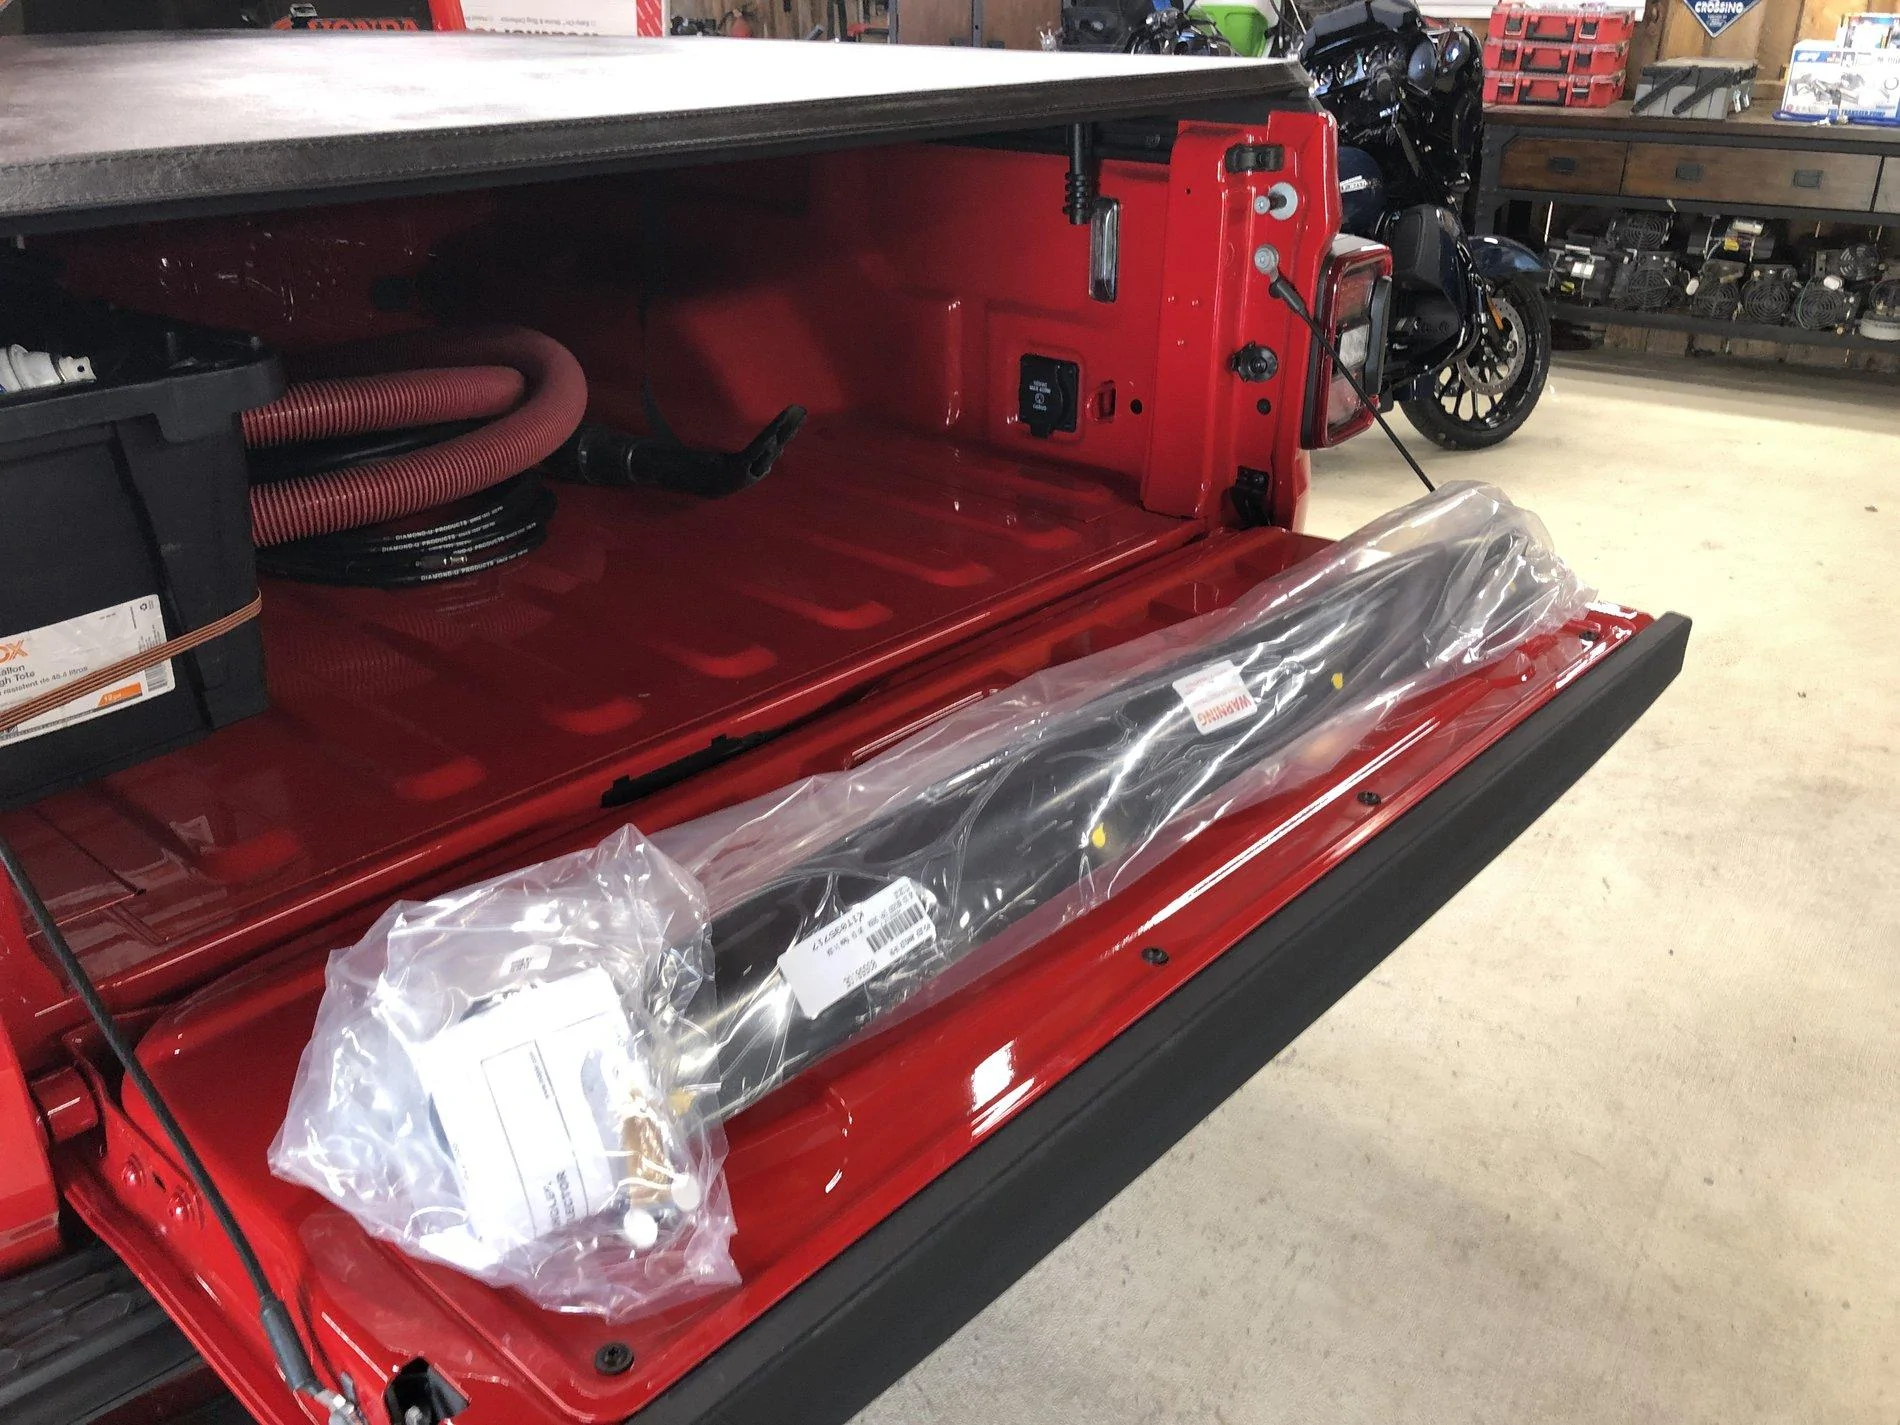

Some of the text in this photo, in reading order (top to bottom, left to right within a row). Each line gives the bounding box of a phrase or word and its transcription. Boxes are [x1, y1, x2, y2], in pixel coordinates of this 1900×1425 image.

[1694, 1, 1744, 14] CROSSING
[434, 520, 468, 533] PRODUCTS
[421, 534, 456, 545] PRODUCTS
[474, 536, 505, 550] PRODUCTS
[460, 560, 494, 573] PRODUCTS
[1197, 694, 1252, 726] WARNING
